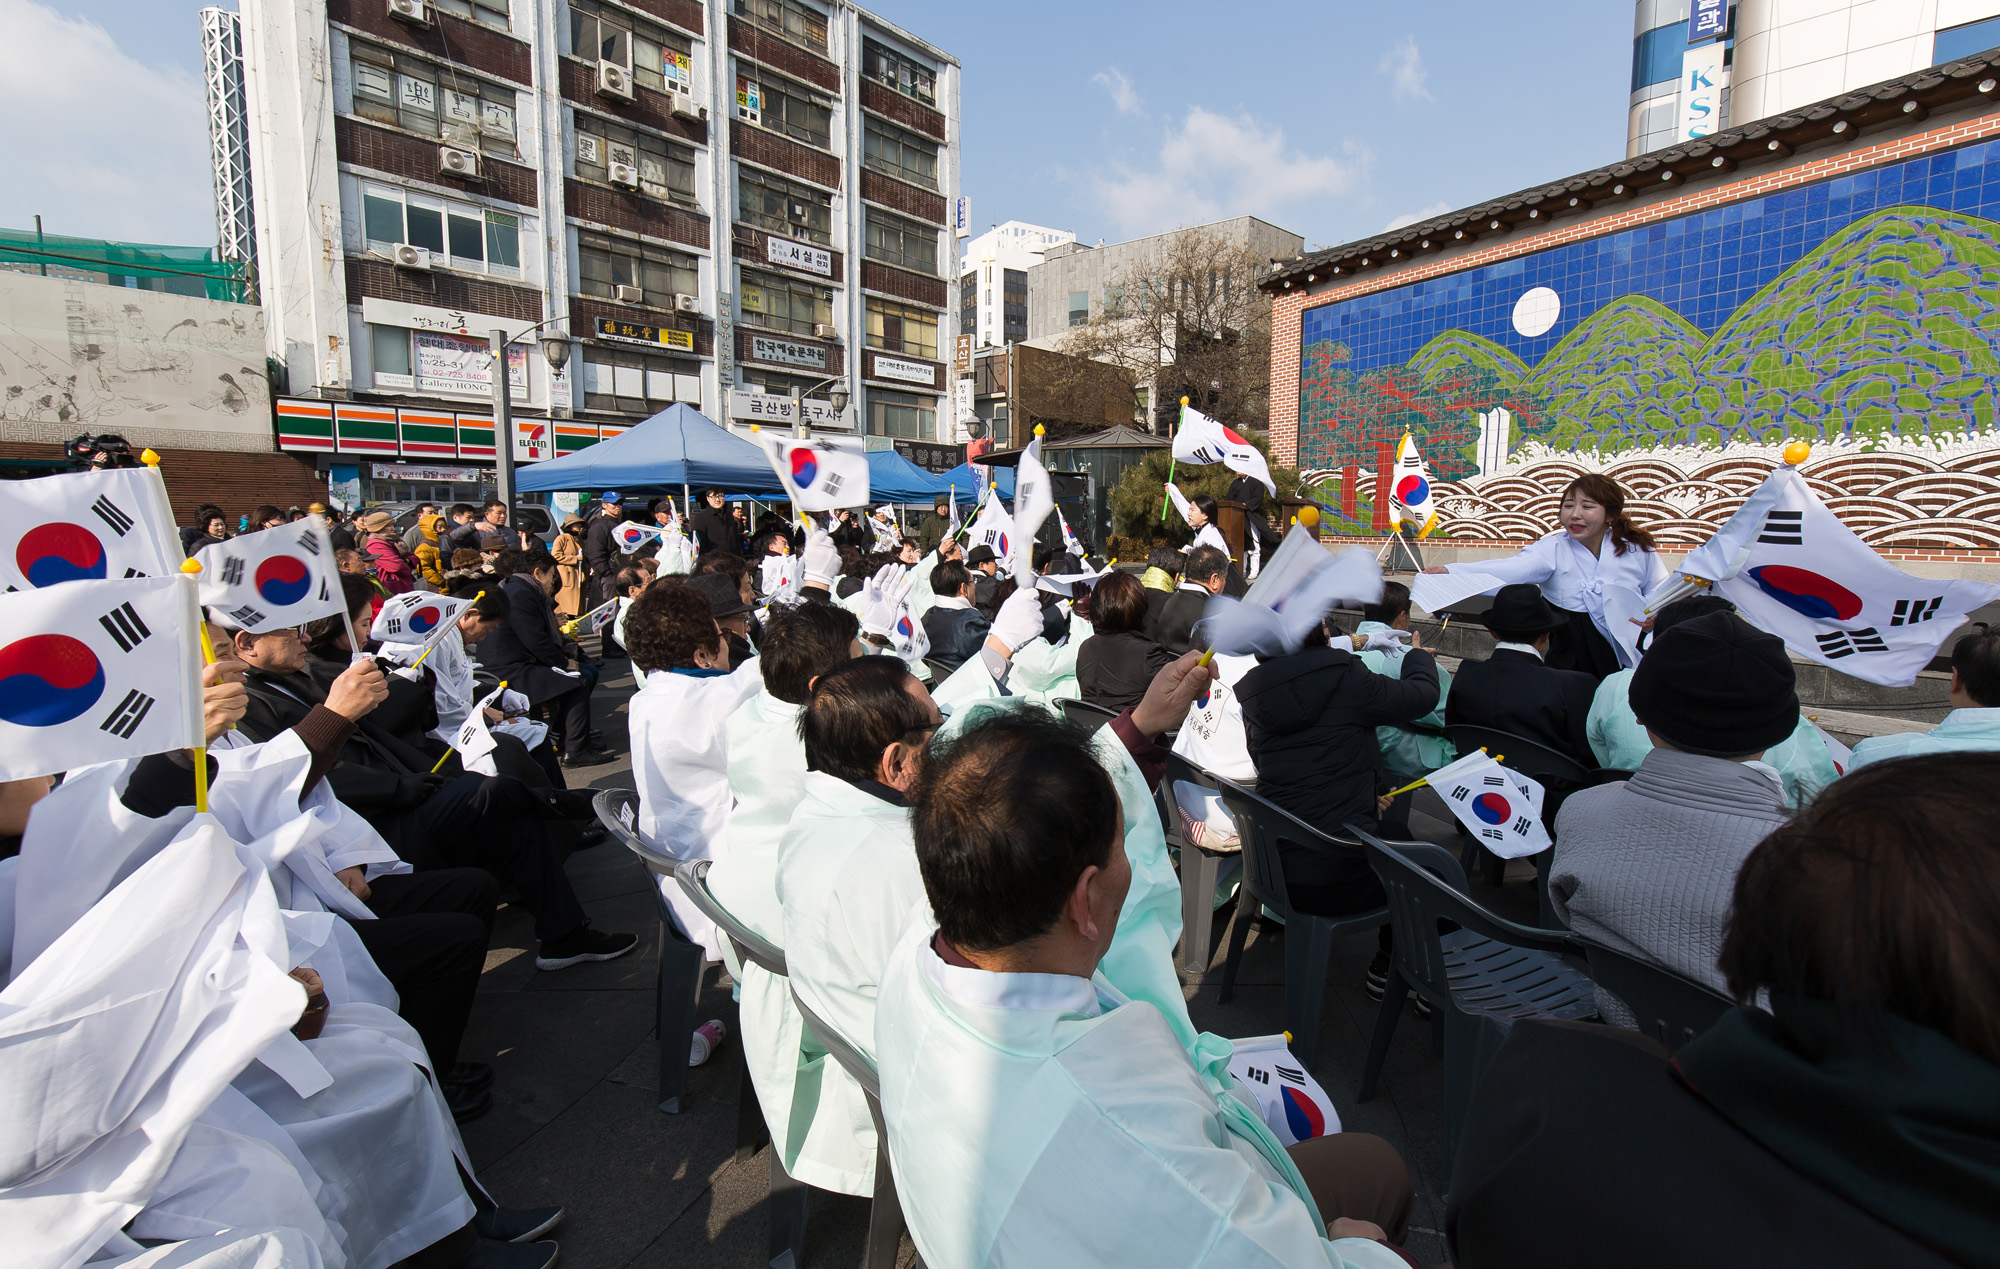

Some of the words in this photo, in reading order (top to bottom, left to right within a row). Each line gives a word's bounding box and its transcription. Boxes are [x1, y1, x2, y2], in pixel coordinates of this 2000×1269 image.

[790, 247, 812, 264] 서실
[413, 316, 449, 329] 갤러리
[755, 338, 825, 361] 한국예술문화원
[958, 338, 969, 360] 효산
[420, 378, 454, 390] Gallery
[456, 380, 488, 392] HONG
